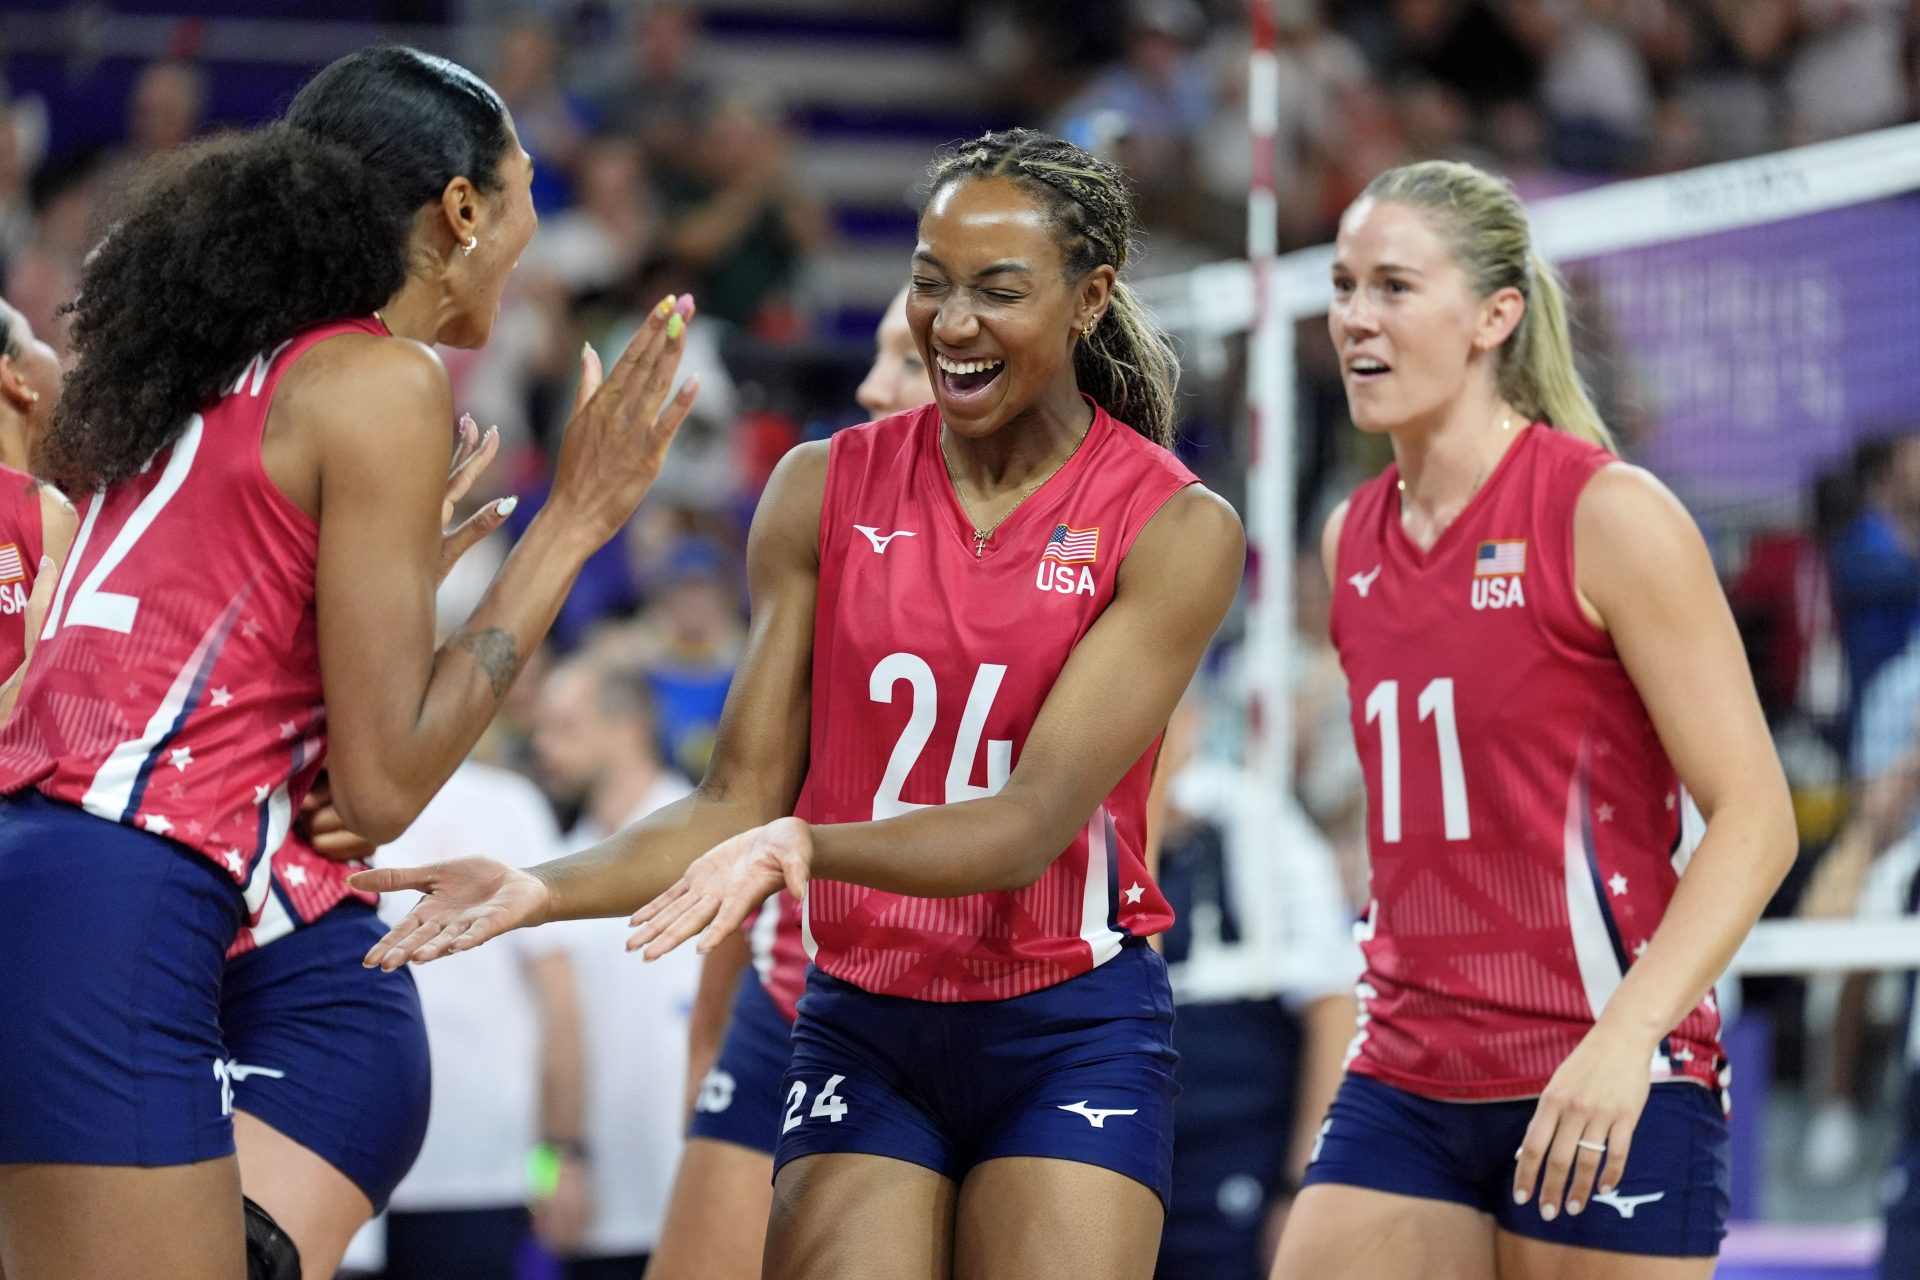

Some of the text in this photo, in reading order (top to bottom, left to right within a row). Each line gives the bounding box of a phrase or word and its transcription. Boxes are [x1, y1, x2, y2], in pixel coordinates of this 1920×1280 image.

[0, 582, 27, 615] SA
[1036, 562, 1096, 596] USA
[1471, 576, 1525, 610] USA
[869, 652, 1013, 821] 24
[1365, 677, 1471, 843] 11
[782, 1074, 848, 1135] 24
